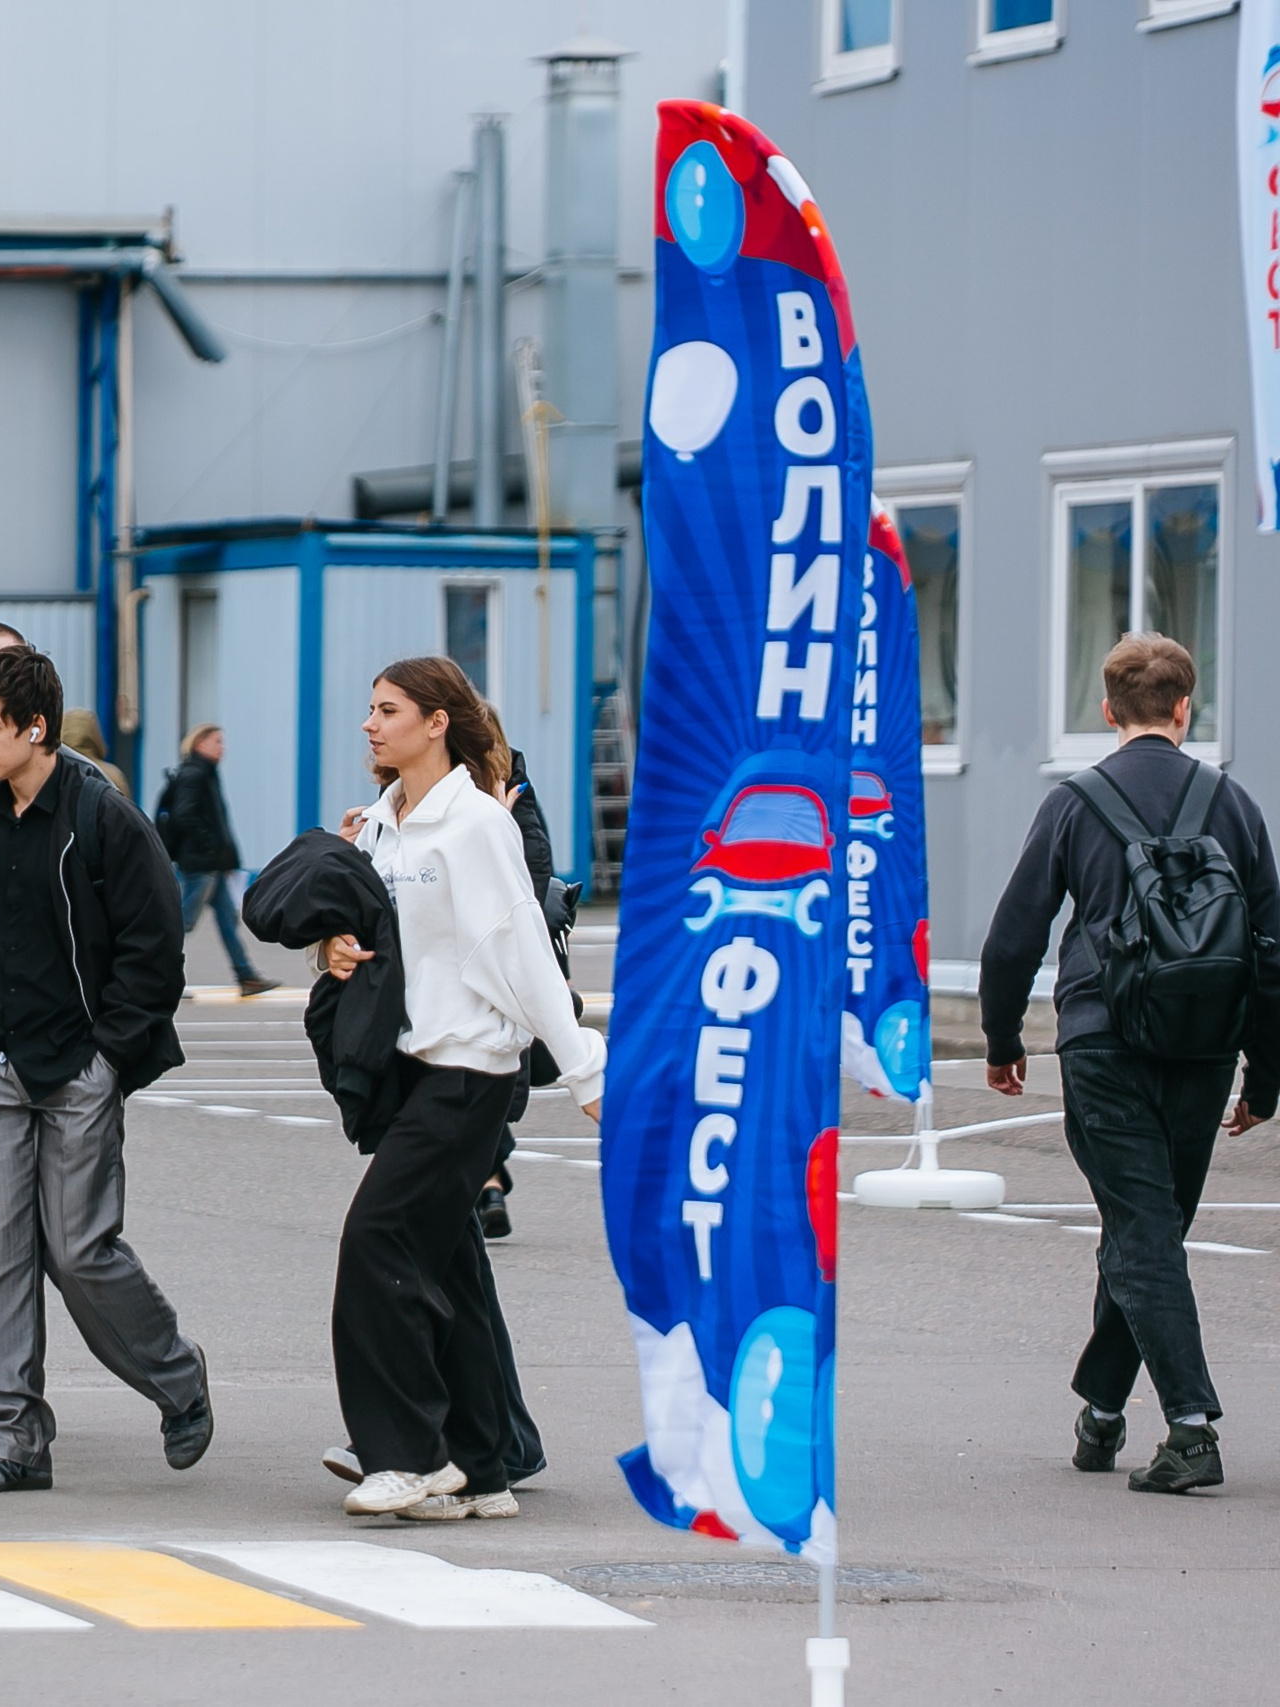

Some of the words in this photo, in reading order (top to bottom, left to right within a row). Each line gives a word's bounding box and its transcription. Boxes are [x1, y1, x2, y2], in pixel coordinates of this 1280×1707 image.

[756, 291, 842, 719] ВОЛИН
[846, 840, 877, 994] ФЕСТ
[681, 936, 781, 1281] ФЕСТ
